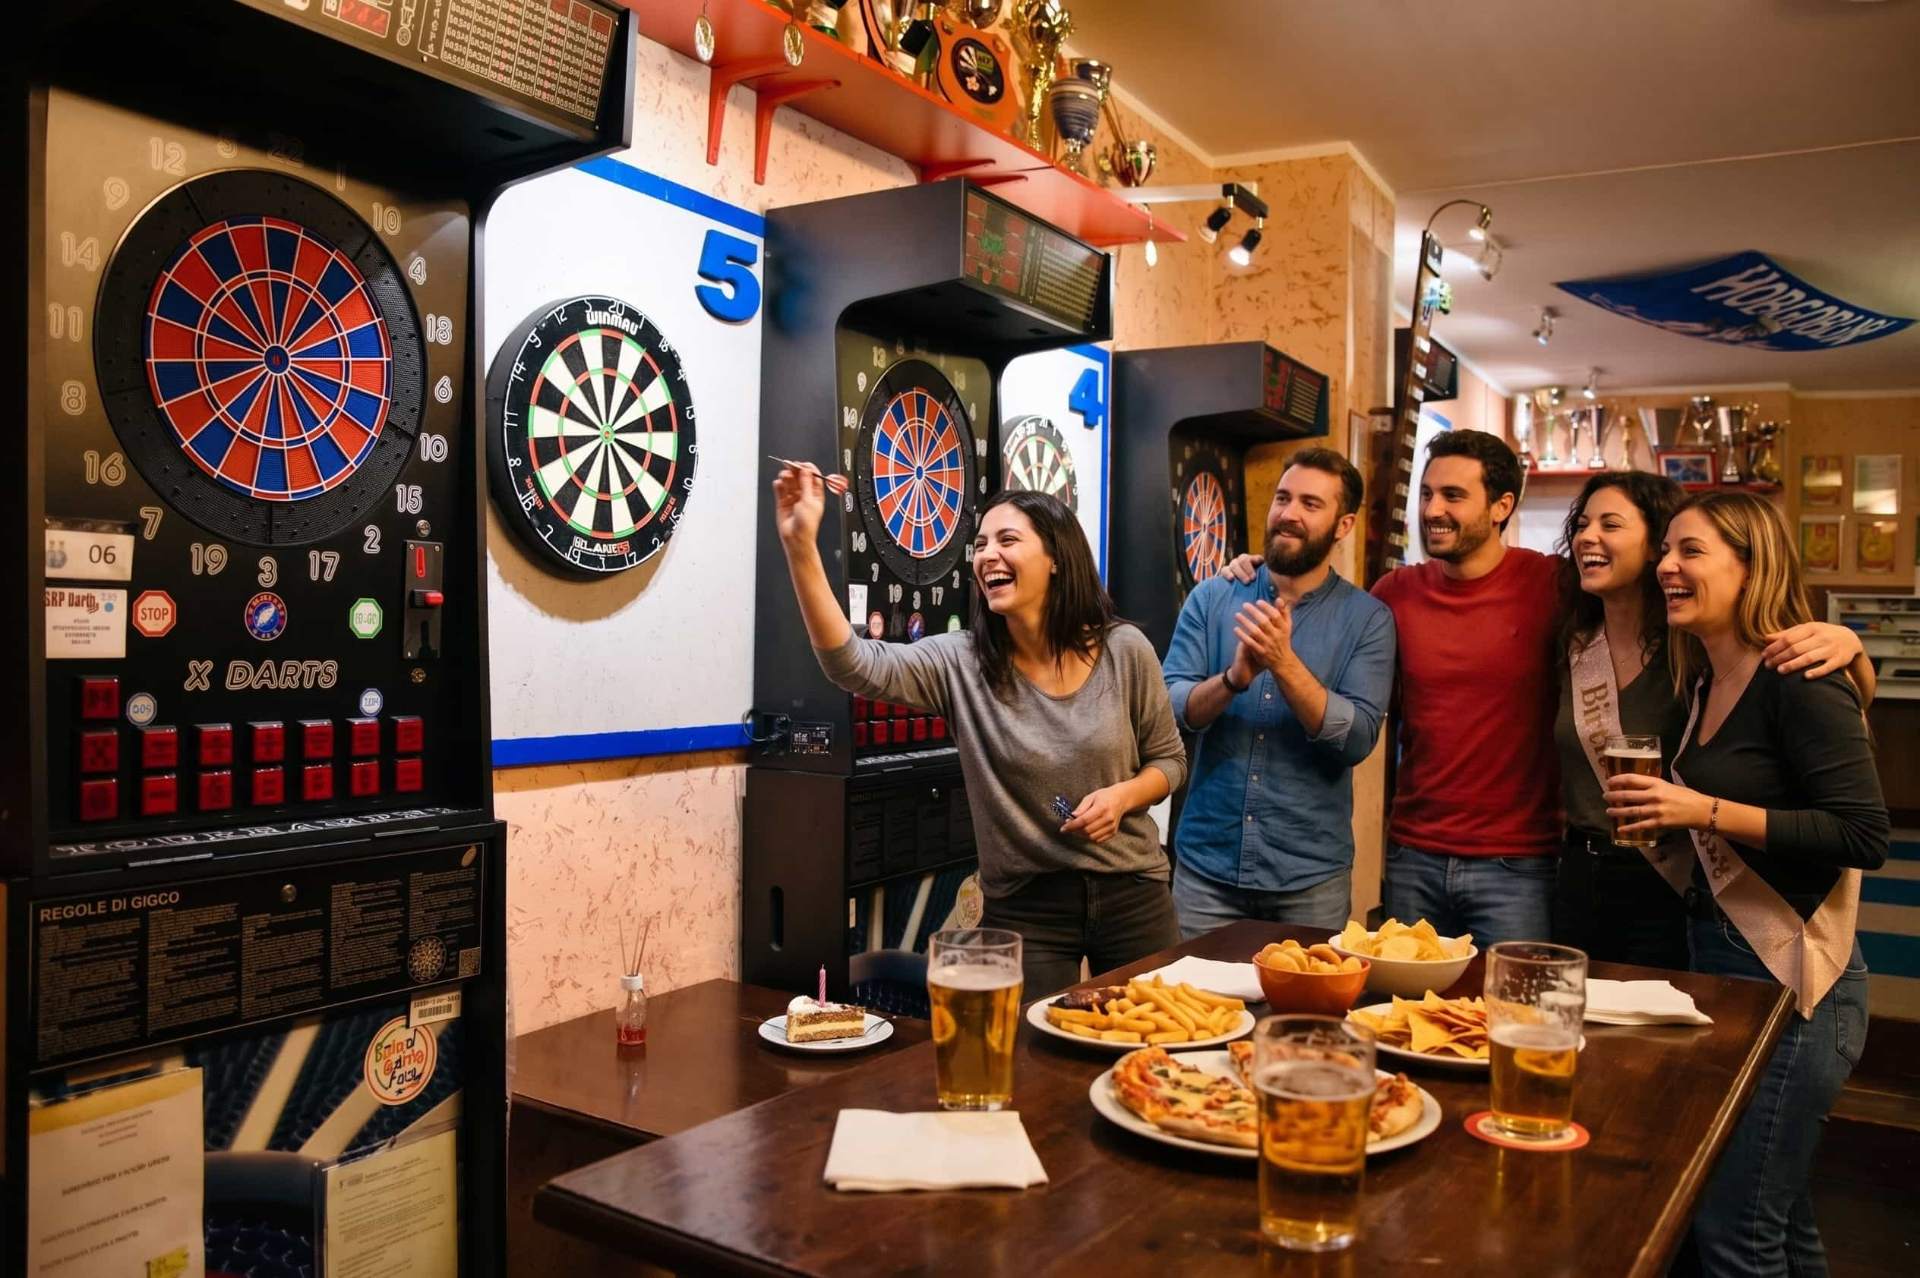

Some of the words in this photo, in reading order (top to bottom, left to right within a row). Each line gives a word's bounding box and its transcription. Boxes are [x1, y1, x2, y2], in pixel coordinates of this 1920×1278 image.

[150, 136, 187, 177] 12
[103, 176, 130, 210] 9
[372, 202, 401, 236] 10
[60, 231, 101, 272] 14
[409, 256, 426, 286] 4
[695, 228, 762, 325] 5
[49, 302, 84, 343] 11
[552, 306, 569, 326] 12
[585, 309, 640, 336] WINMAU
[608, 299, 626, 317] 20
[426, 313, 453, 346] 18
[528, 333, 543, 349] 9
[657, 337, 669, 353] 18
[510, 360, 527, 382] 14
[61, 380, 87, 416] 8
[434, 375, 453, 404] 6
[1068, 367, 1102, 431] 4
[420, 432, 449, 463] 10
[509, 457, 522, 468] 8
[84, 449, 127, 487] 16
[396, 484, 423, 515] 15
[140, 506, 164, 541] 7
[89, 544, 116, 565] 06
[363, 524, 381, 555] 2
[852, 531, 867, 553] 16
[190, 542, 228, 576] 19
[257, 556, 278, 588] 3
[309, 550, 340, 582] 17
[932, 587, 944, 606] 17
[141, 608, 169, 621] STOP
[184, 659, 214, 691] X
[225, 659, 339, 691] DARTS
[40, 900, 107, 922] REGOLE
[112, 897, 127, 912] DI
